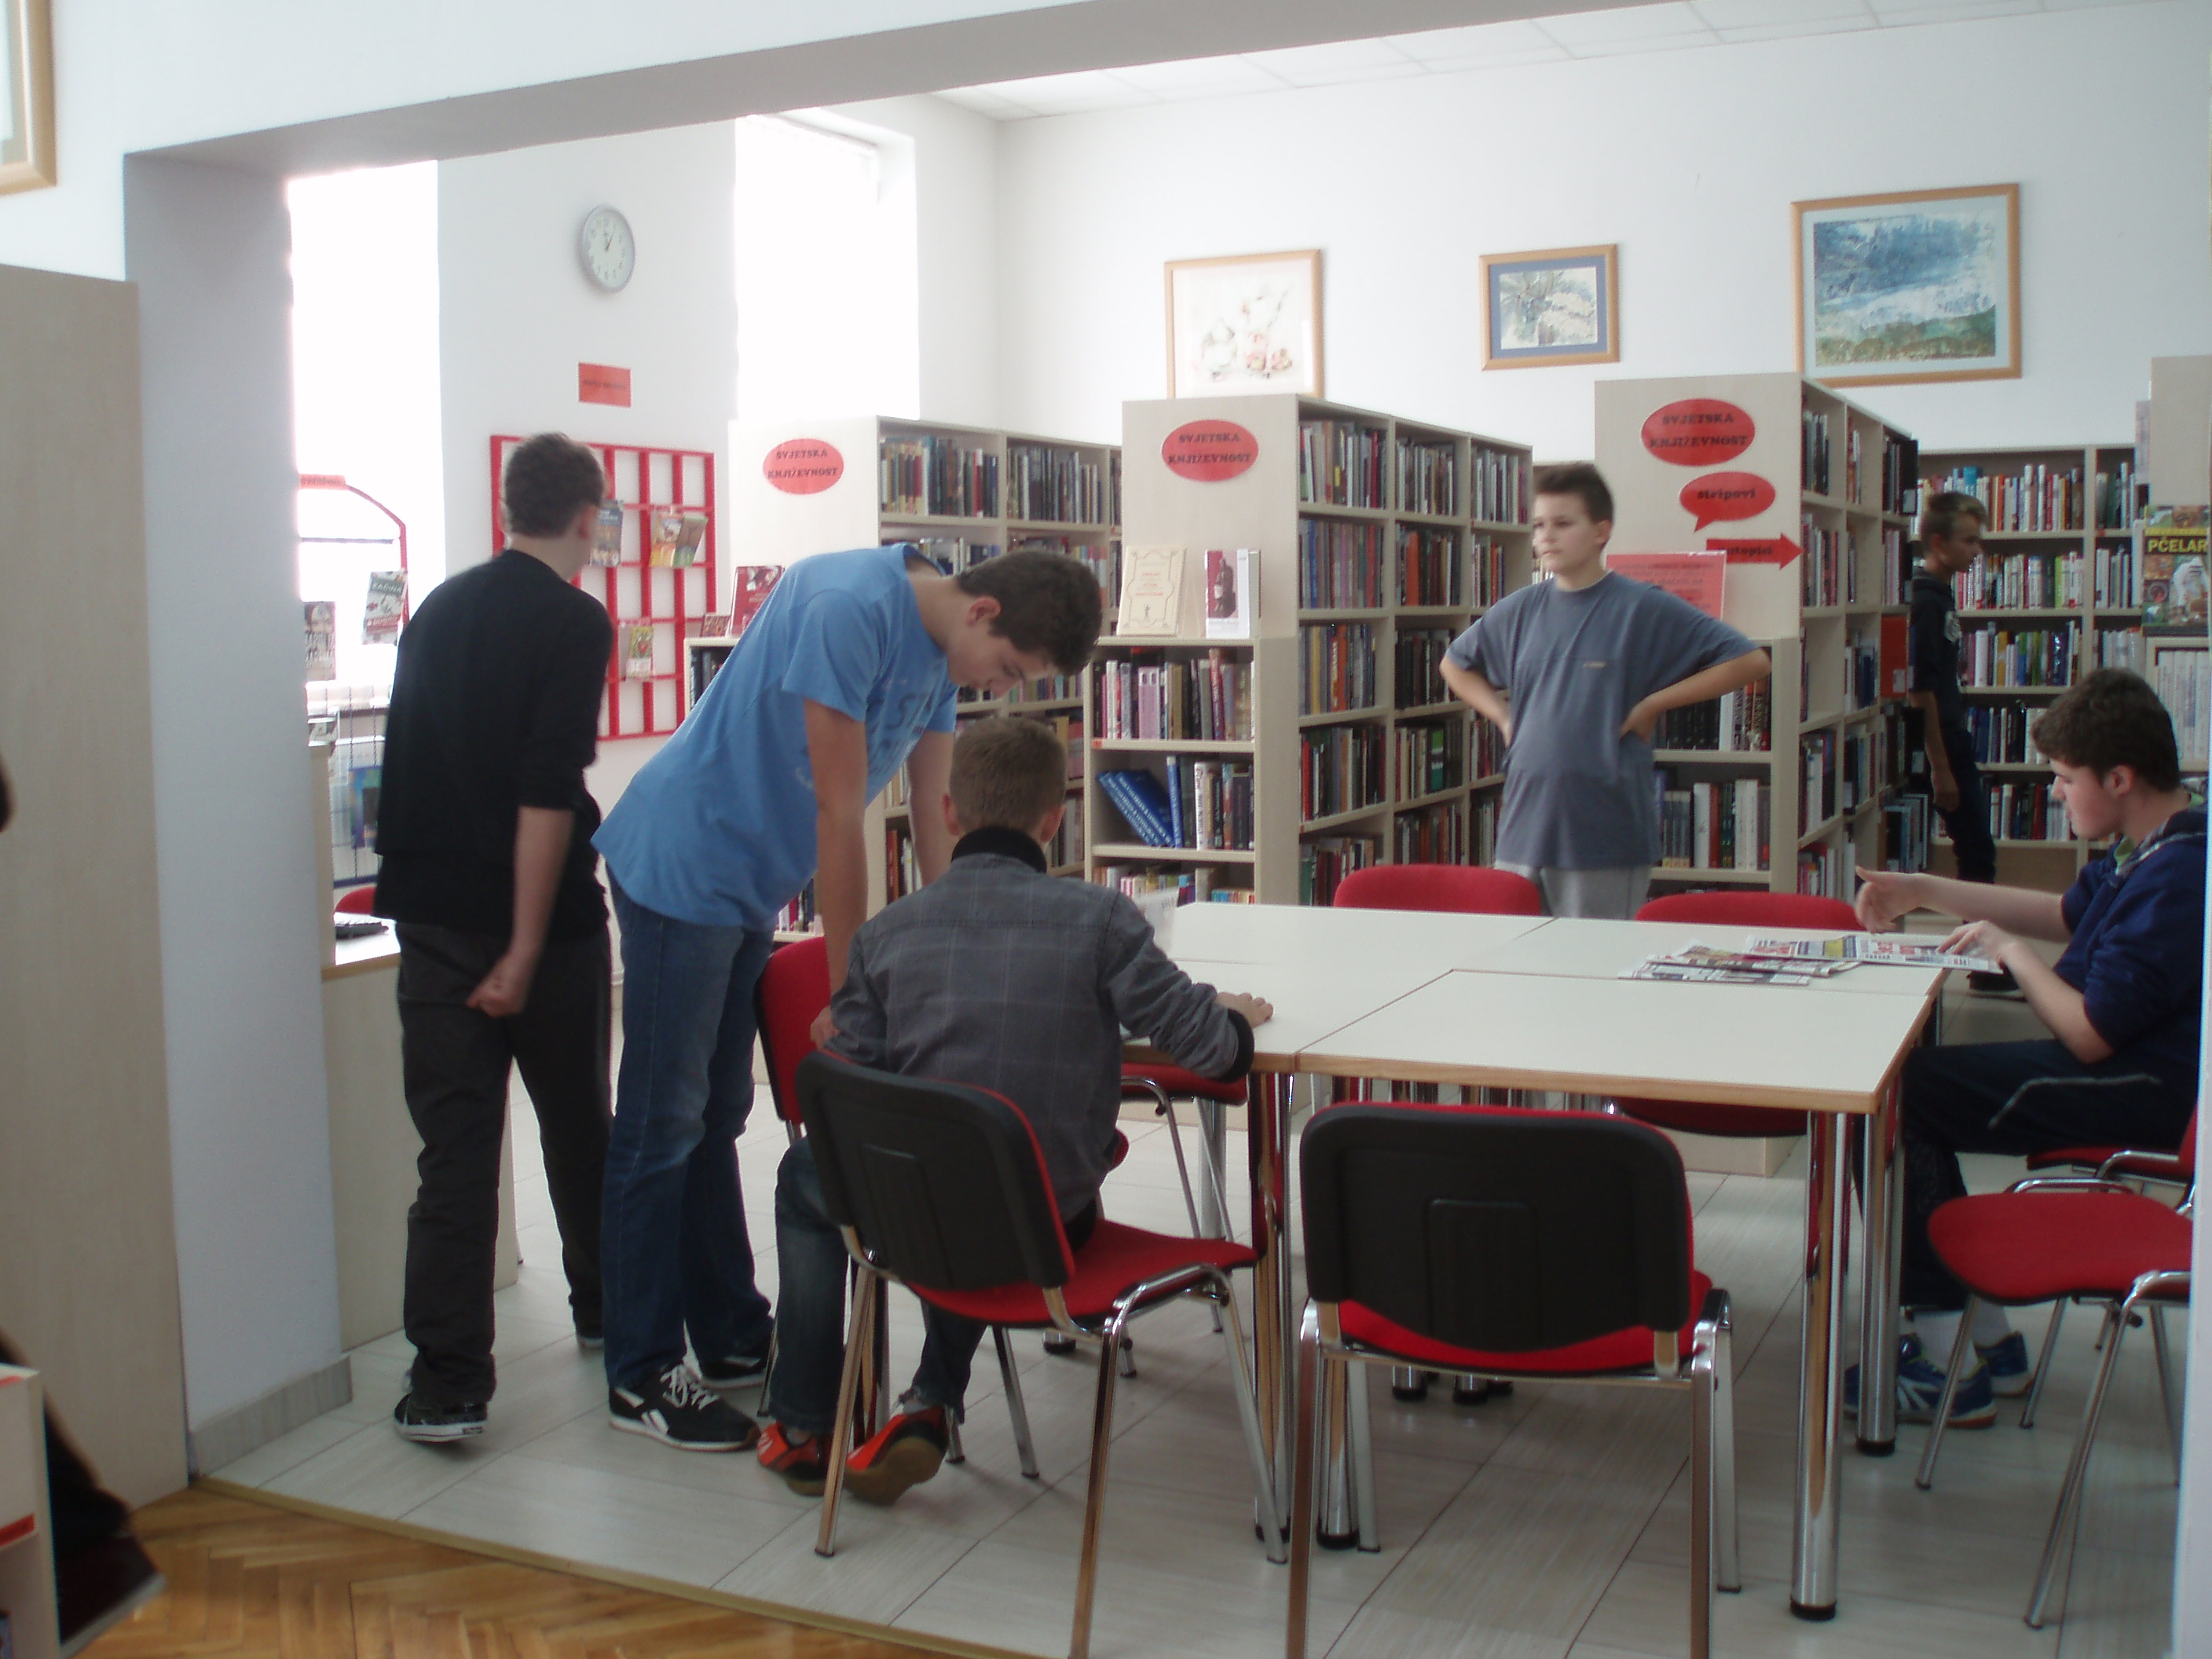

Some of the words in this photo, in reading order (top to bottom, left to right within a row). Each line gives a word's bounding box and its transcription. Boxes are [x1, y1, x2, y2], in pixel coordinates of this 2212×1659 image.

[1661, 413, 1734, 424] SVJETSKA
[1179, 432, 1240, 442] SVJETSKA
[1650, 434, 1746, 447] KNJIŽEVNOST
[775, 449, 827, 459] SVJETSKA
[1168, 452, 1251, 463] KNJIŽEVNOST
[767, 467, 836, 478] KNJIŽEVNOST
[1697, 488, 1756, 500] stripovi
